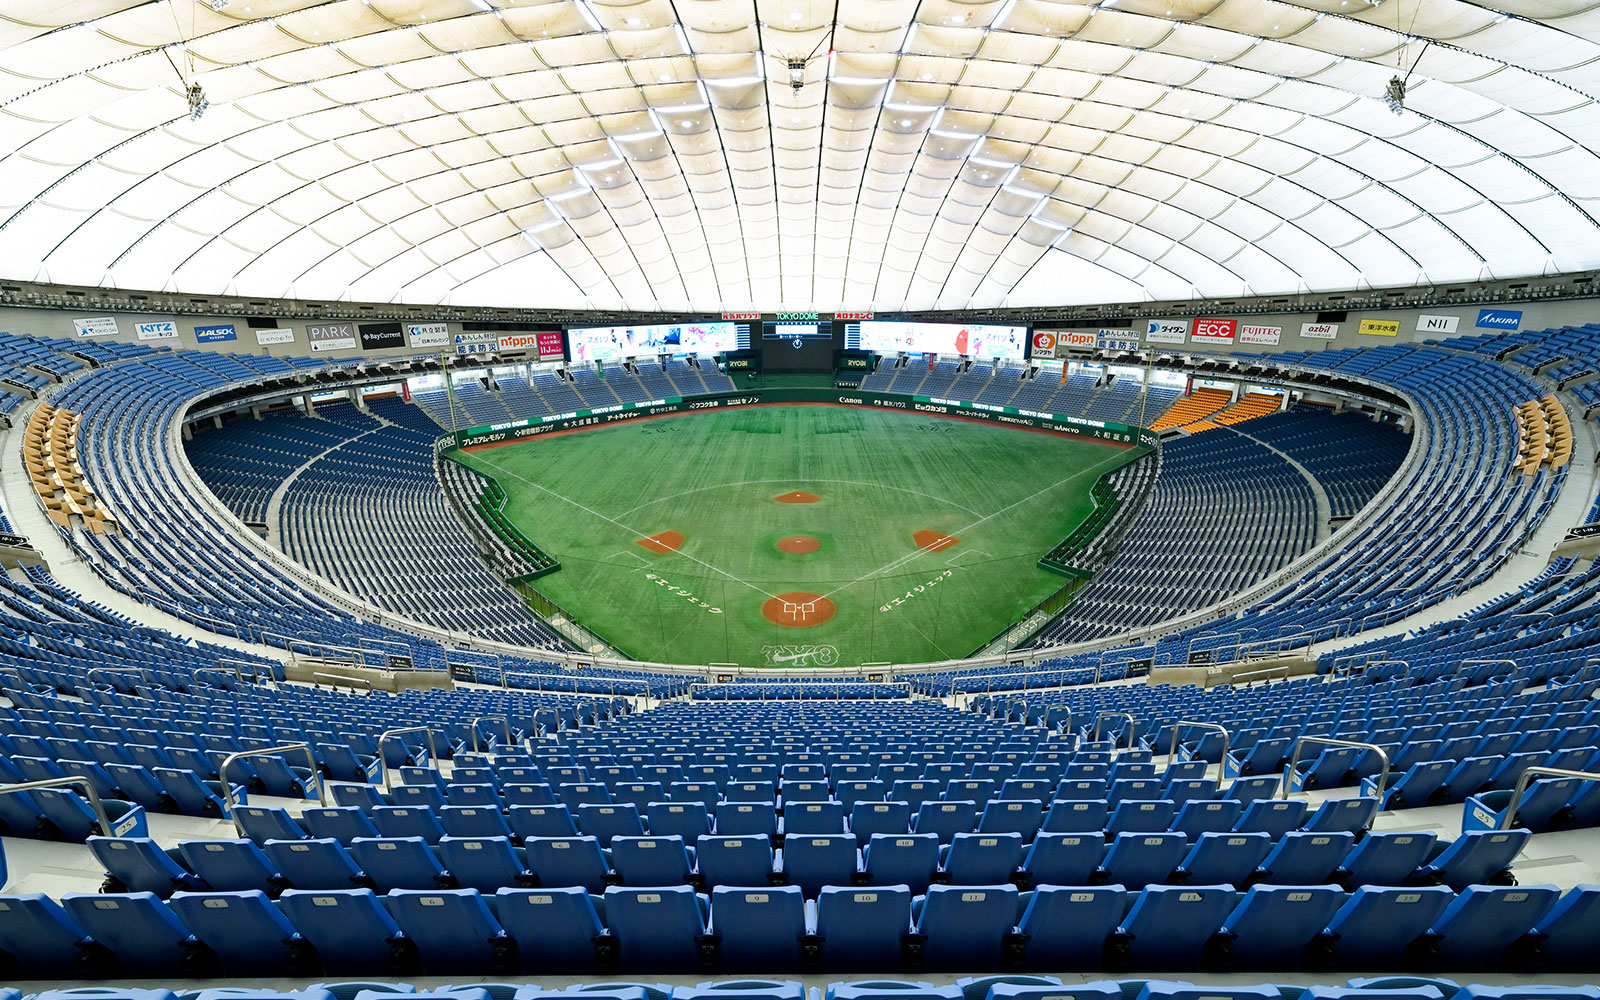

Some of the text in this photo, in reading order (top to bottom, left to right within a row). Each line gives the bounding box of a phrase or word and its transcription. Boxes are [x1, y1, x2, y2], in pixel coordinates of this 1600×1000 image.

[141, 323, 172, 333] KITZ
[1162, 325, 1185, 334] ダイダン
[1427, 319, 1448, 329] NII
[312, 326, 350, 339] PARK
[1197, 324, 1230, 336] ECC
[1243, 327, 1280, 336] FUJITEC
[501, 336, 534, 347] nippn
[1060, 333, 1094, 344] nippn
[915, 404, 947, 413] ビックカメラ
[542, 414, 560, 422] TOKYO
[1054, 425, 1079, 434] SANKYO
[891, 570, 952, 606] エイジェック
[655, 579, 723, 614] エイジェック
[1478, 812, 1489, 823] 25
[121, 822, 132, 833] 25
